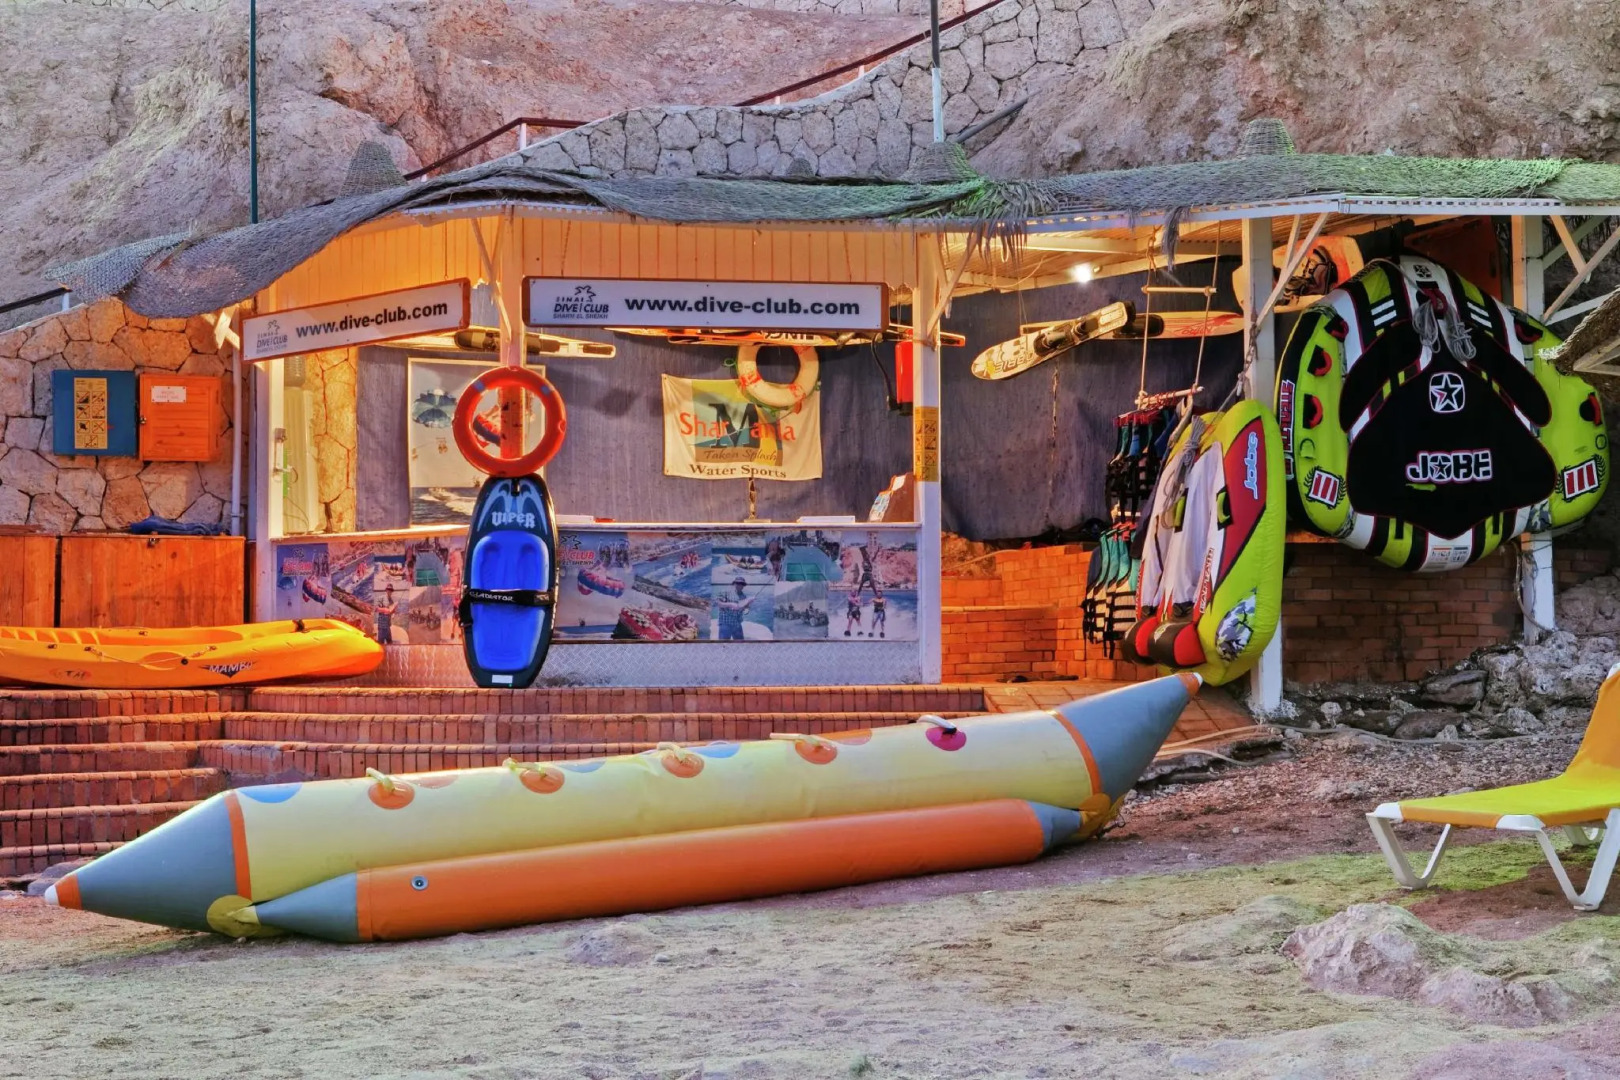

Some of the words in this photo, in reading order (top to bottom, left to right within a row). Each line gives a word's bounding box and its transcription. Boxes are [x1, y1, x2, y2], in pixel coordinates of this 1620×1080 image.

[553, 303, 579, 313] DIVE
[583, 303, 610, 313] CLUB
[624, 296, 860, 316] www.dive-club.com
[295, 302, 448, 338] www.dive-club.com
[689, 464, 737, 477] Water
[741, 464, 788, 478] Sports
[1405, 449, 1493, 483] JOBE
